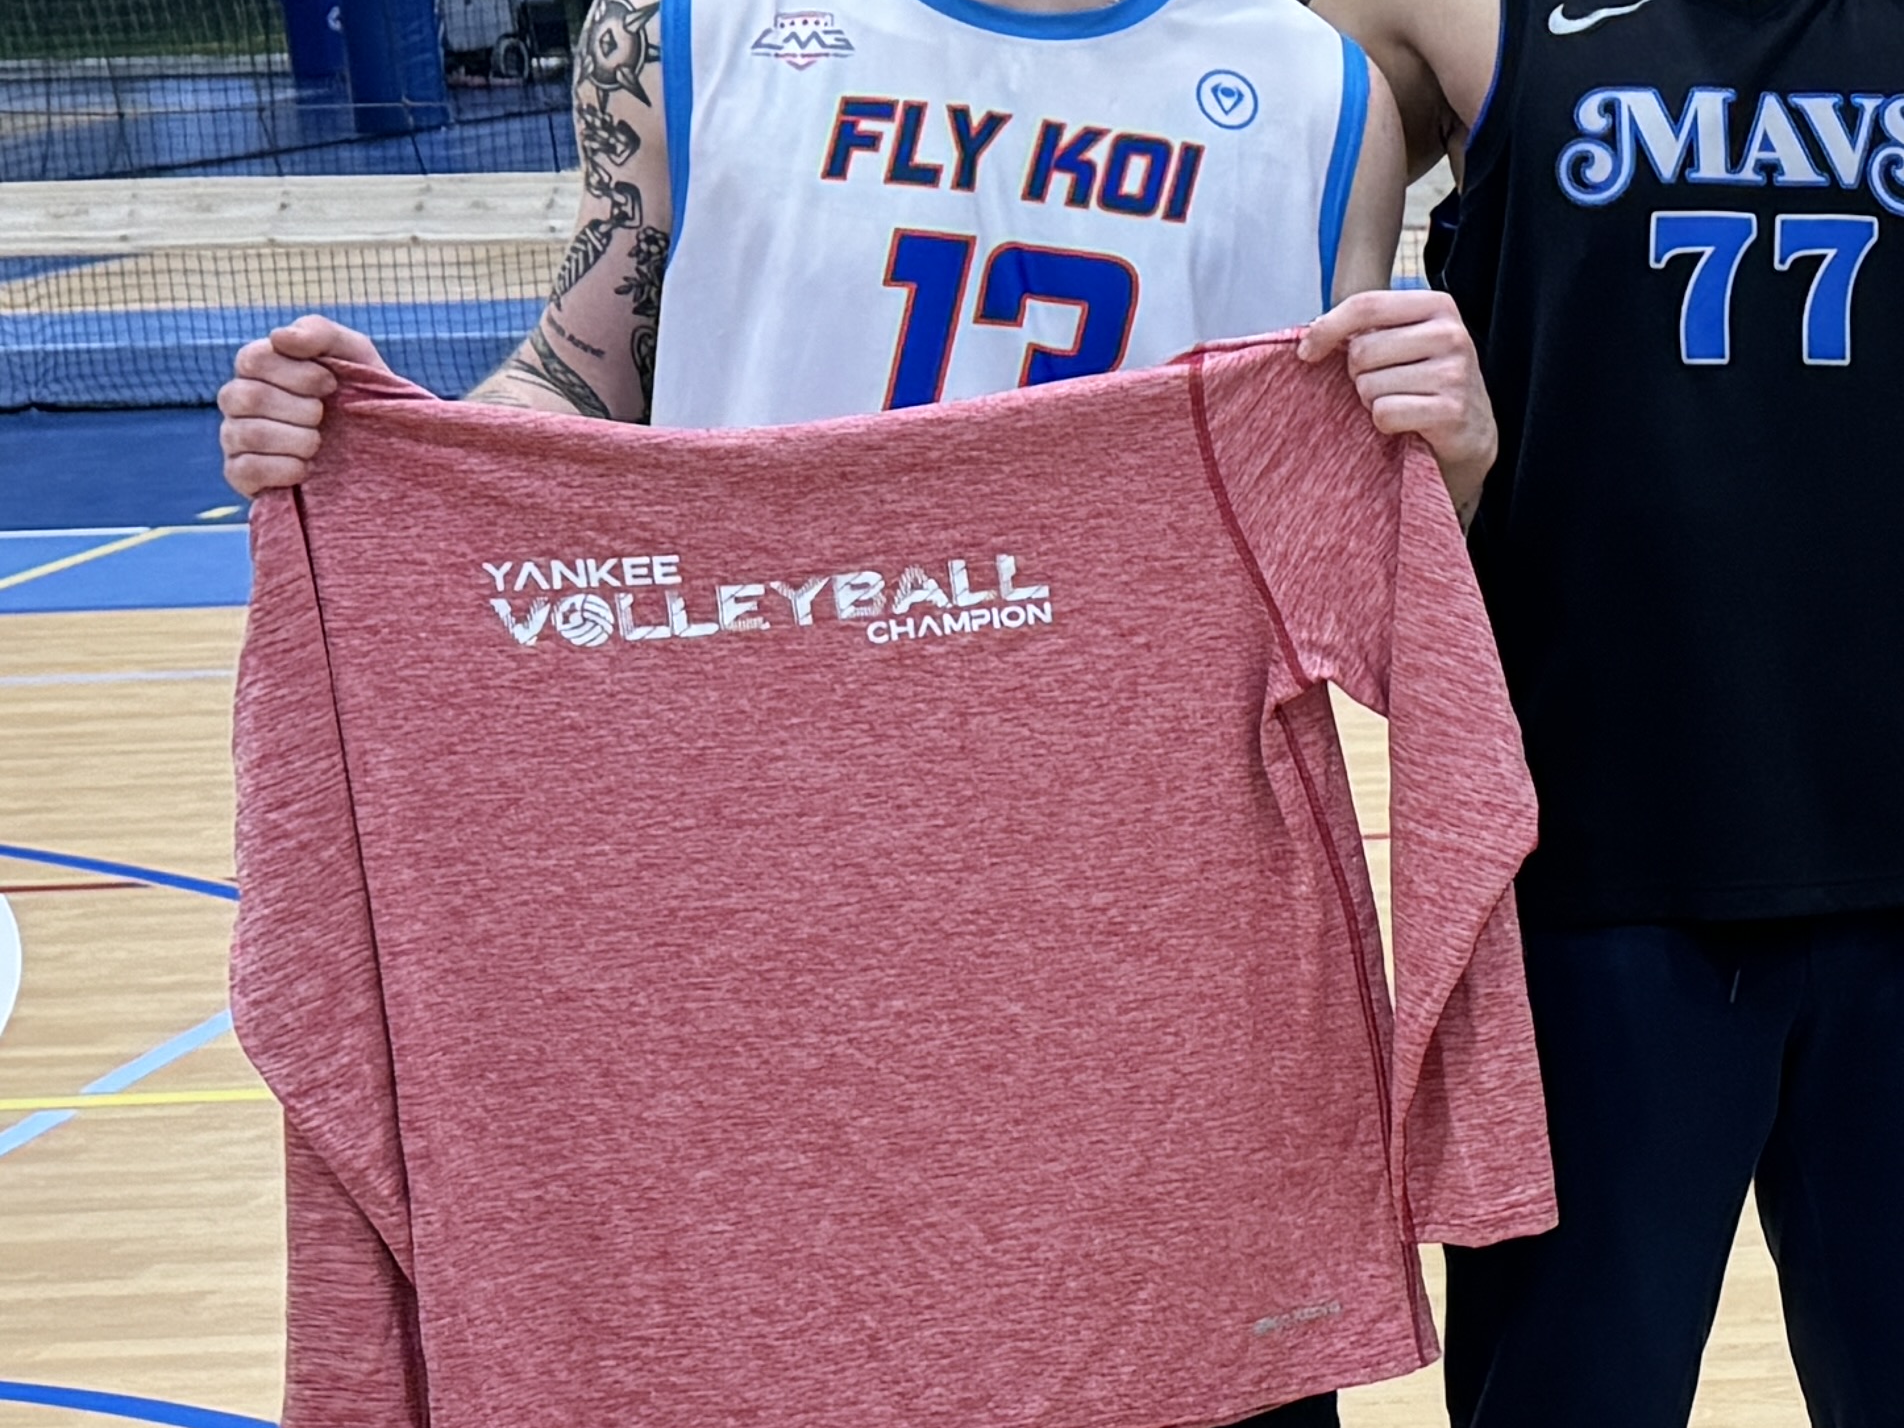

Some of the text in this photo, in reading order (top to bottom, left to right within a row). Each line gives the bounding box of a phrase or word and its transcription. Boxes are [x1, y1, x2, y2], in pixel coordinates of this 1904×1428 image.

[820, 95, 1205, 223] FLY KOI
[1649, 210, 1879, 366] 77
[482, 555, 682, 592] YANKEE
[489, 554, 1050, 647] VOLLEYBALL
[866, 602, 1053, 645] CHAMPION
